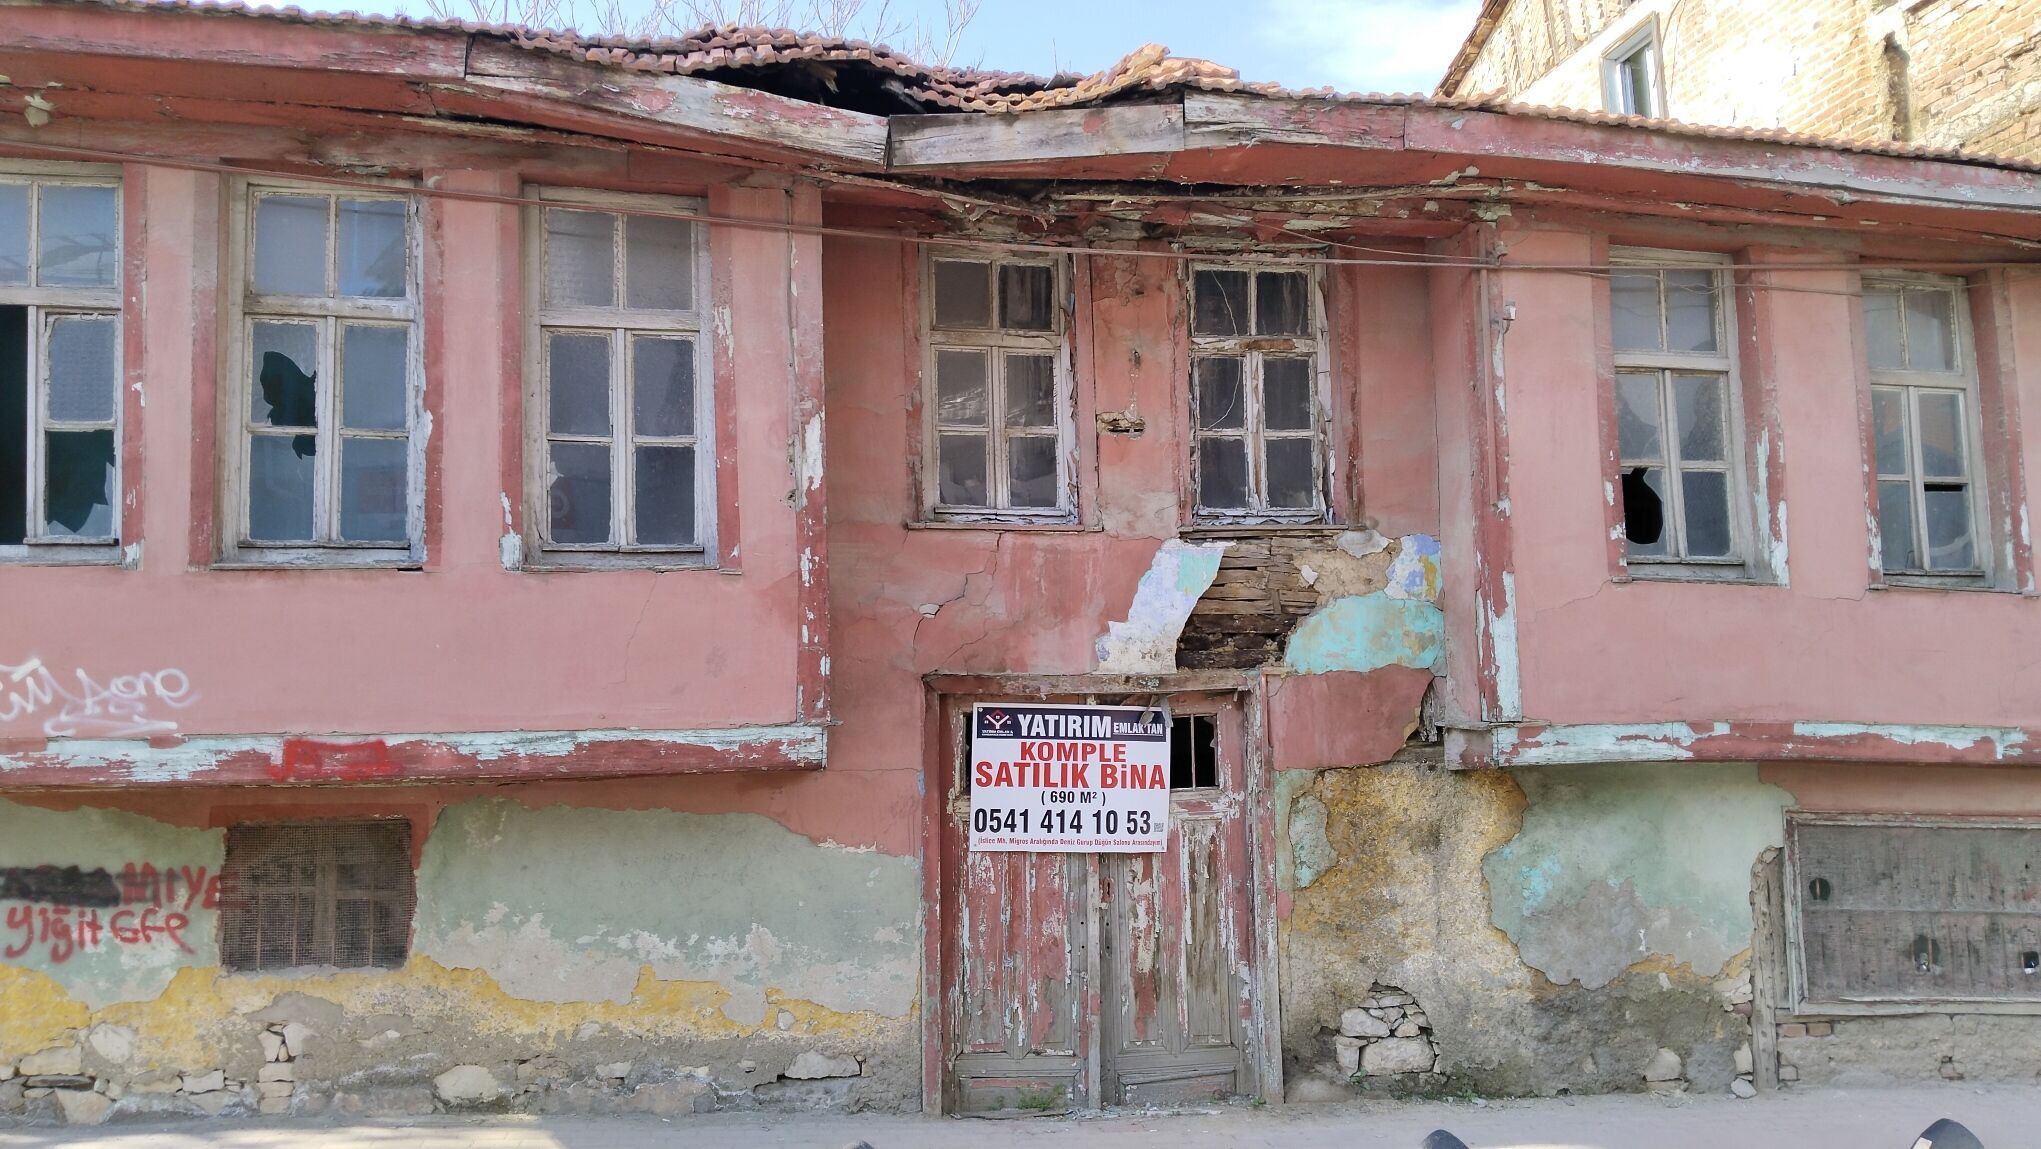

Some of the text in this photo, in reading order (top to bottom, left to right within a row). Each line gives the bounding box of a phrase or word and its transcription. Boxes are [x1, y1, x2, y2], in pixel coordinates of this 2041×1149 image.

[1017, 714, 1163, 738] YATIRIM EMLAK'TAN
[1020, 741, 1127, 763] KOMPLE
[975, 761, 1090, 788] SATILIK
[1050, 791, 1075, 804] 690
[974, 808, 1151, 835] 0541 414 10 53
[1009, 837, 1029, 846] Migros
